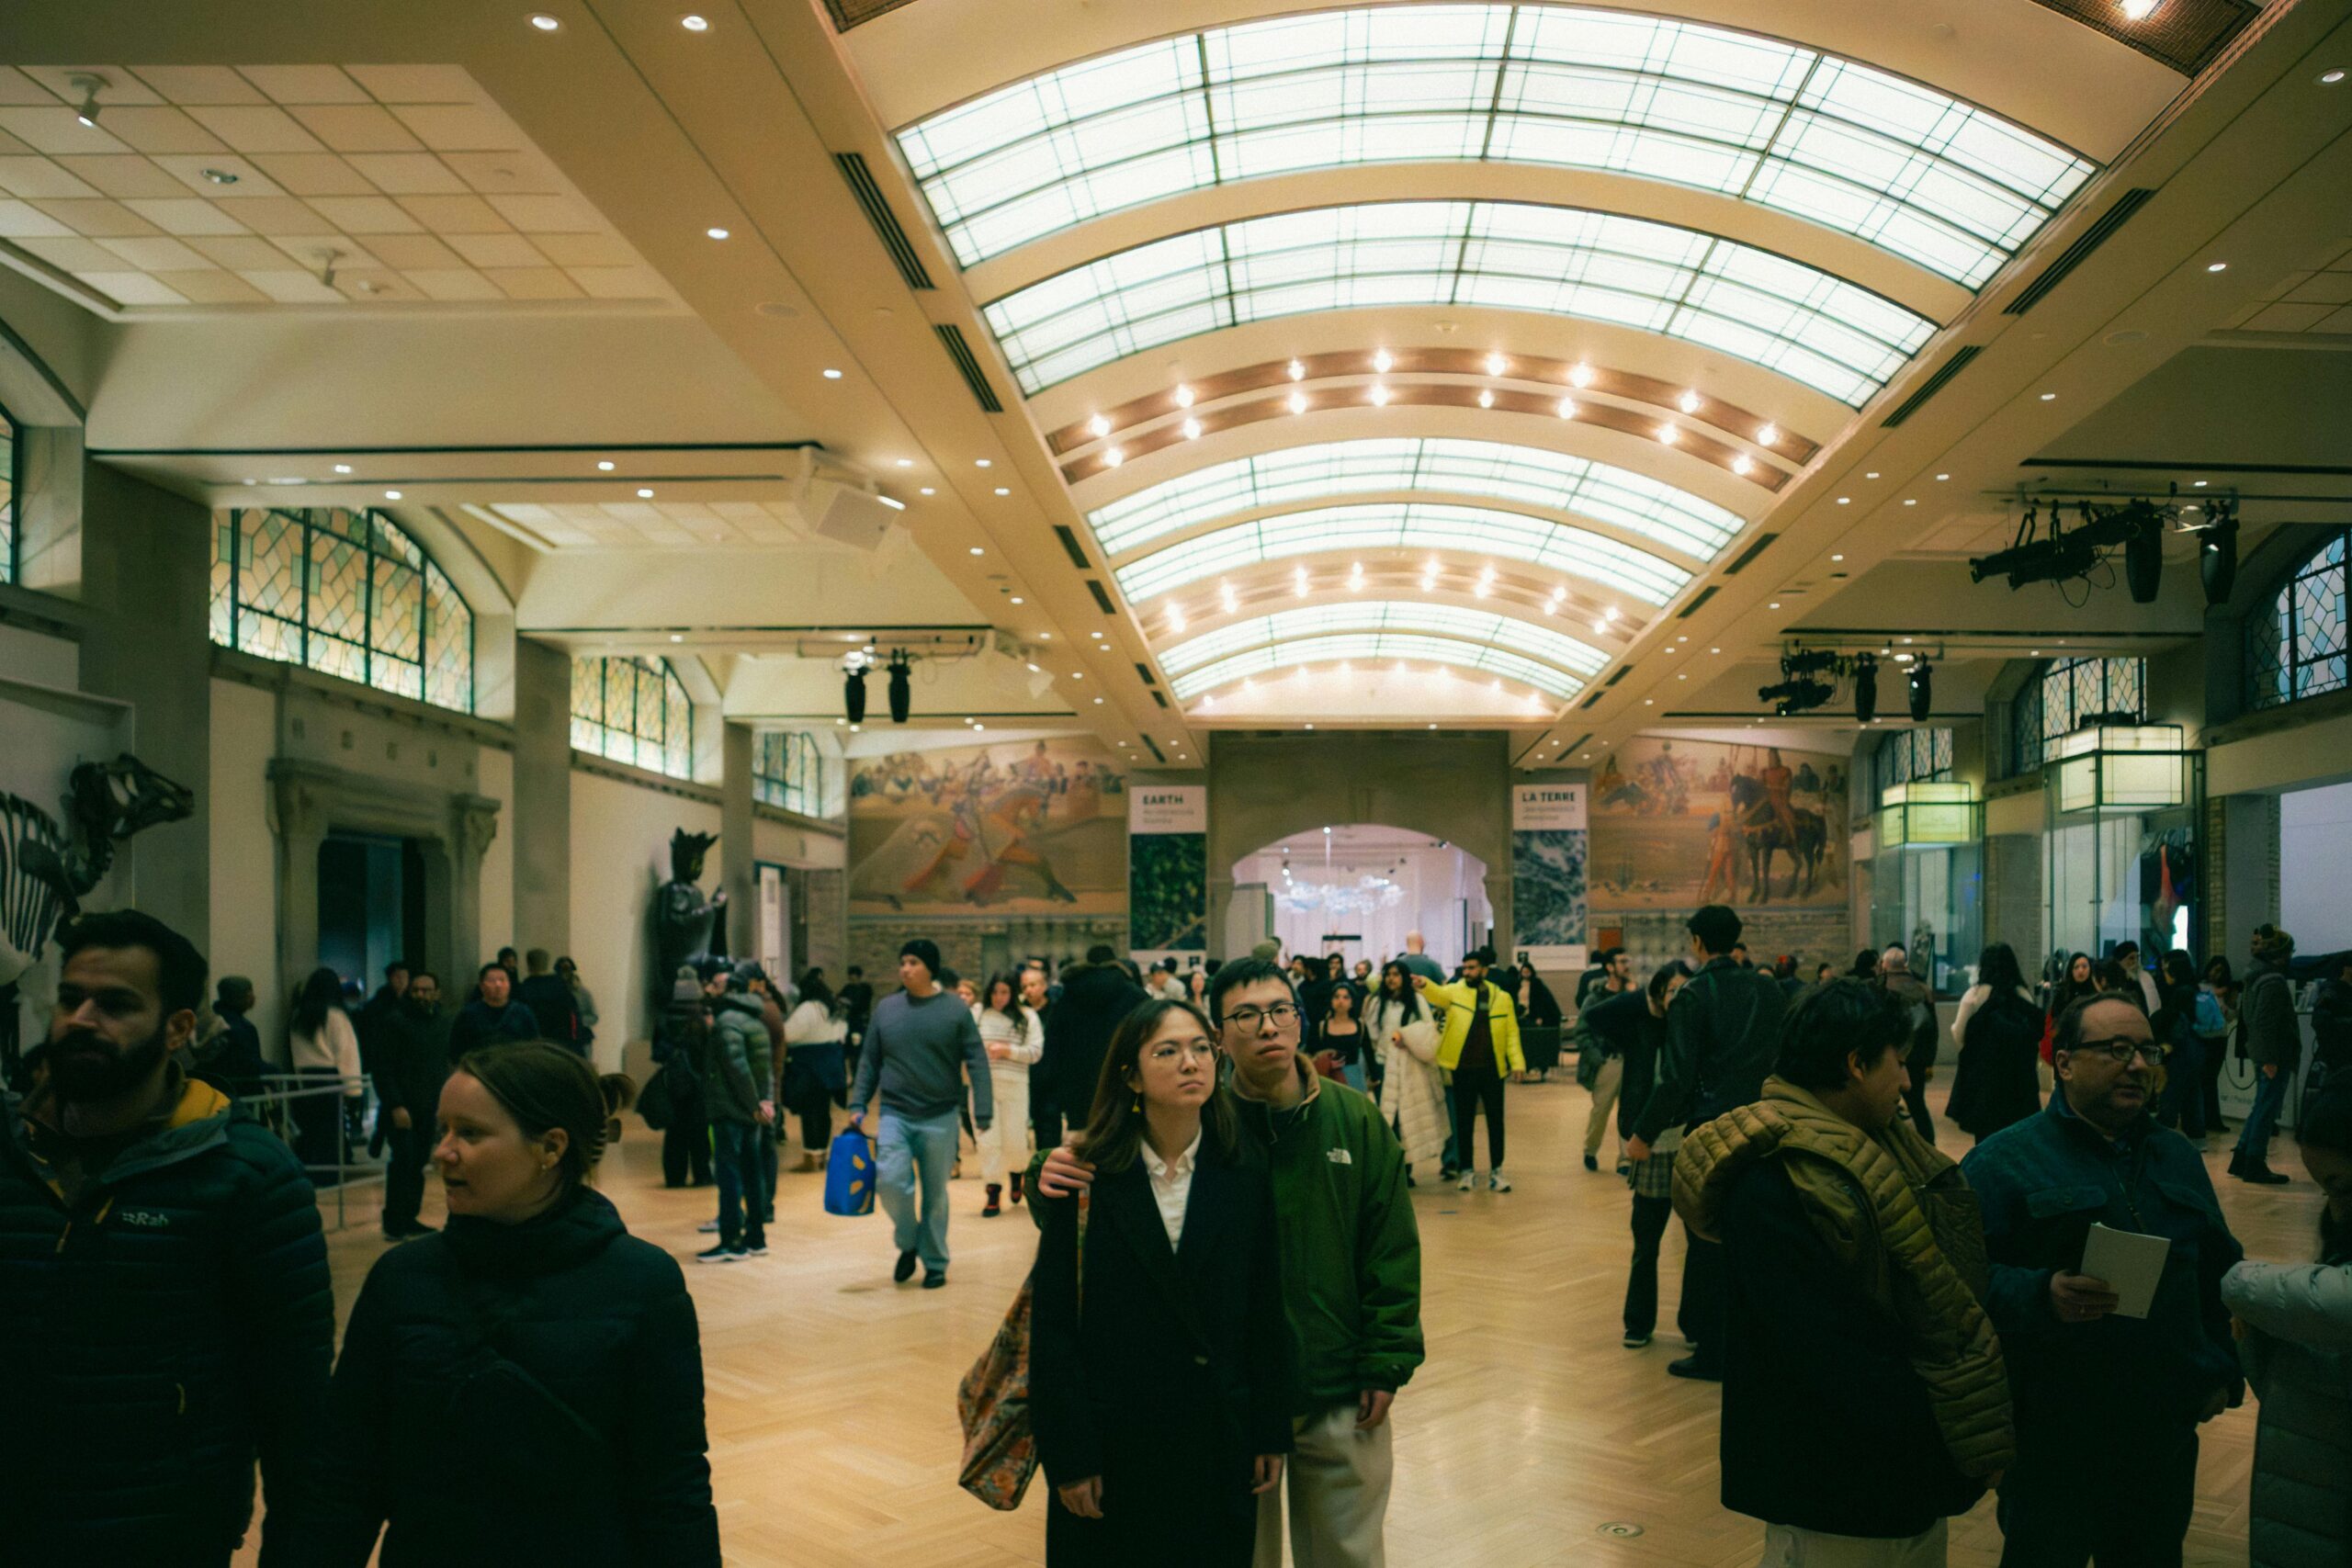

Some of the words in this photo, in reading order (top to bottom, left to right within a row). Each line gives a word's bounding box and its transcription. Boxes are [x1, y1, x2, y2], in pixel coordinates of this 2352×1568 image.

[1143, 795, 1183, 805] EARTH
[1522, 792, 1537, 802] LA
[1541, 792, 1575, 802] TERRE
